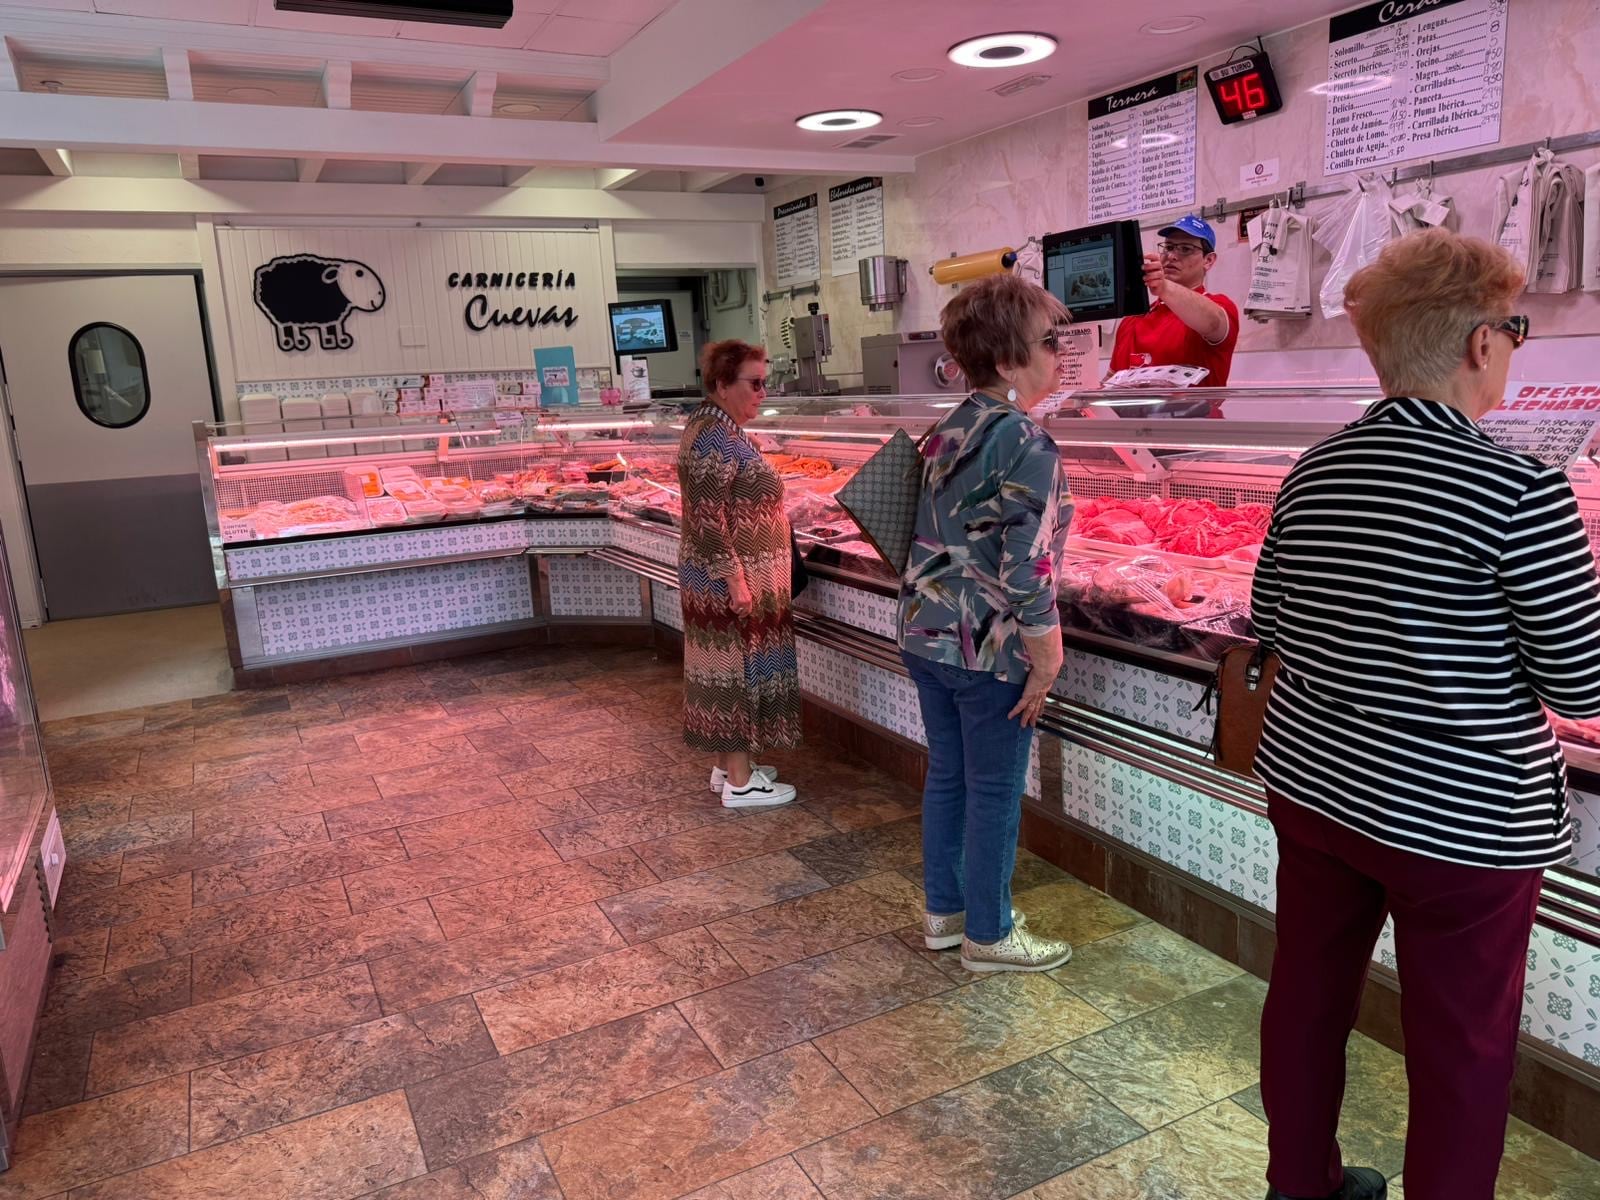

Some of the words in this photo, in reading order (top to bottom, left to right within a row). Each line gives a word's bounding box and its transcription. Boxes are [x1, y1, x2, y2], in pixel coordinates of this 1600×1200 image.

[1418, 18, 1448, 32] Lenguas
[1418, 34, 1436, 45] Patas
[1335, 42, 1364, 58] Solomillo
[1416, 45, 1440, 56] Orejas
[1231, 61, 1251, 72] TURNO
[1334, 57, 1358, 69] Secreto
[1416, 58, 1440, 69] Tocino
[1334, 69, 1357, 80] Secreto
[1359, 62, 1383, 73] Ibérico
[1416, 70, 1438, 81] Magro
[1220, 73, 1265, 110] 46
[1414, 78, 1456, 93] Carrilladas
[1106, 87, 1158, 112] Ternera
[1333, 94, 1350, 103] Presa
[1414, 94, 1441, 106] Panceta
[1333, 103, 1354, 114] Delicia
[1414, 107, 1436, 118] Pluma
[1439, 100, 1465, 112] Ibérica
[1332, 116, 1349, 126] Lomo
[1352, 111, 1372, 121] Fresco
[1412, 115, 1448, 129] Carrillada
[1452, 109, 1478, 121] Ibérica
[1332, 128, 1349, 137] Filete
[1360, 118, 1382, 130] Jamón
[1412, 132, 1430, 142] Presa
[1433, 126, 1459, 137] Ibérica
[1331, 137, 1354, 148] Chuleta
[1366, 131, 1385, 140] Lomo
[1331, 149, 1354, 159] Chuleta
[1366, 141, 1385, 152] Aguja
[1330, 159, 1353, 170] Costilla
[1356, 156, 1376, 165] Fresca
[448, 269, 576, 289] CARNICERÍA
[465, 294, 579, 331] Cuevas
[1494, 418, 1529, 426] medios
